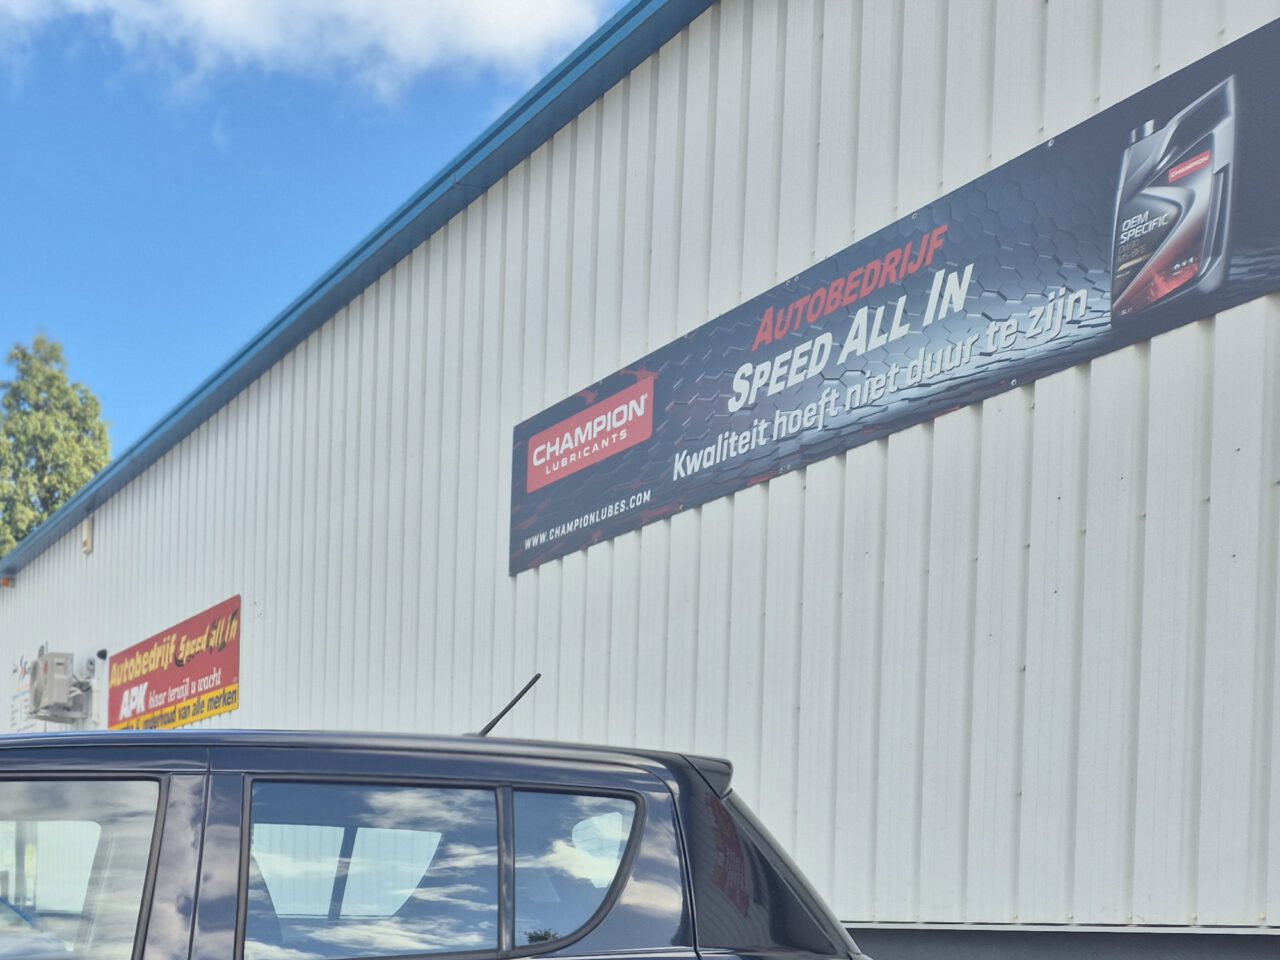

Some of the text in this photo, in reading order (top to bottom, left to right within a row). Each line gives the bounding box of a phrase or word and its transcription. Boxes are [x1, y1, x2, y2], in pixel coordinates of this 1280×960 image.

[1119, 212, 1170, 245] SPECIFIC
[1122, 210, 1150, 231] OEM
[728, 263, 975, 413] SPEED ALL IN
[673, 286, 1088, 482] Kwaliteit hoeft niet duur te zijn
[533, 393, 648, 466] CHAMPION
[545, 428, 628, 475] LUBRICANTS
[524, 489, 652, 550] WWW.CHAMPIONLUBES.COM
[109, 633, 177, 688] Autobedrijf
[118, 681, 149, 720] APK
